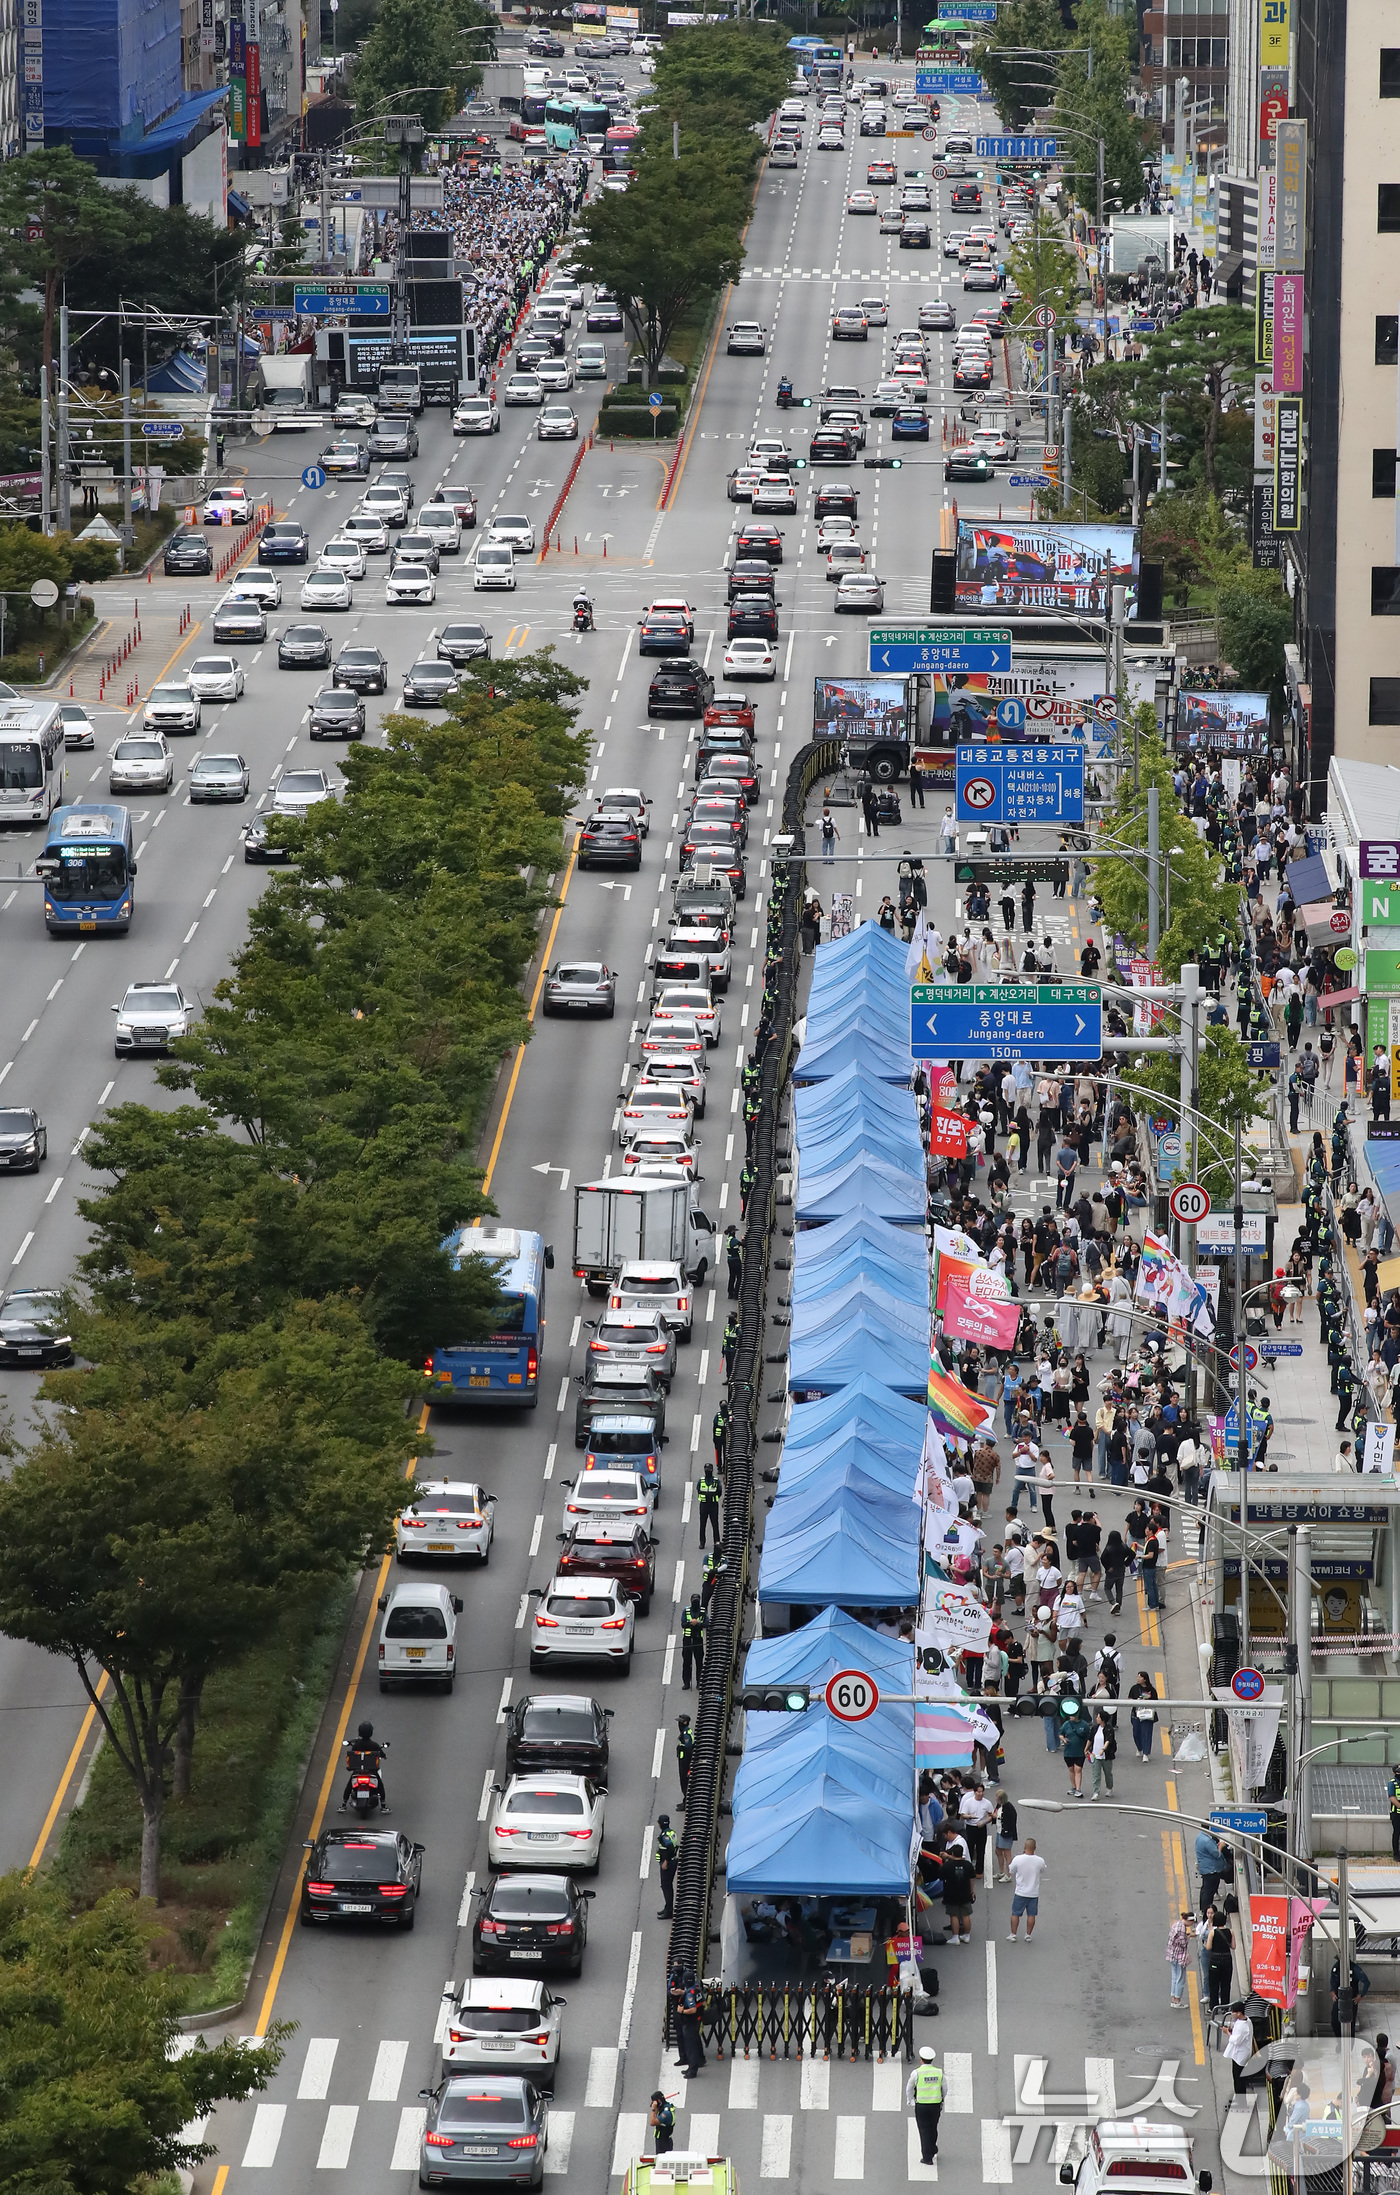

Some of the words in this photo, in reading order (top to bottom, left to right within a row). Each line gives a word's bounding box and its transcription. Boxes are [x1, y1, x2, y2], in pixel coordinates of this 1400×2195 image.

[27, 1, 38, 25] 하이모
[1264, 1, 1287, 23] 과
[1269, 36, 1281, 45] 3F
[234, 85, 243, 134] SUBWAY
[925, 130, 934, 138] 60
[935, 169, 945, 177] 60
[328, 297, 356, 306] 중앙대로
[1261, 488, 1274, 535] 뮤즈의원
[1260, 558, 1273, 566] 5F
[881, 632, 915, 642] 명덕네거리
[928, 632, 963, 642] 계산오거리
[973, 632, 1000, 642] 대구역
[921, 648, 961, 661] 중앙대로
[912, 661, 969, 671] Jungang-daero
[961, 748, 1080, 763] 대중교통전용지구
[1008, 770, 1045, 780] 시내버스
[1063, 788, 1082, 800] 허용
[1007, 796, 1054, 806] 이륜자동차
[1008, 808, 1037, 818] 자전거
[68, 859, 83, 867] 306
[1372, 897, 1389, 918] N
[1331, 916, 1349, 926] 복사
[1115, 950, 1135, 958] 부동산
[1335, 956, 1356, 965] 상담
[926, 988, 971, 1001] 명덕네거리
[989, 988, 1037, 1001] 계산오거리
[1051, 988, 1087, 1001] 대구역
[979, 1010, 1033, 1028] 중앙대로
[968, 1029, 1045, 1041] Jungang-daero
[991, 1047, 1022, 1058] 150m
[936, 1116, 965, 1136] 진보
[1179, 1194, 1201, 1213] 60
[1218, 1220, 1257, 1228] 메트센터
[957, 1316, 983, 1331] 모두의
[1337, 1505, 1365, 1518] 쇼핑
[838, 1683, 867, 1710] 60
[1223, 1818, 1242, 1827] 대구
[1259, 1915, 1279, 1926] ART
[1298, 1915, 1315, 1925] ART
[1252, 1924, 1286, 1935] DAEGU
